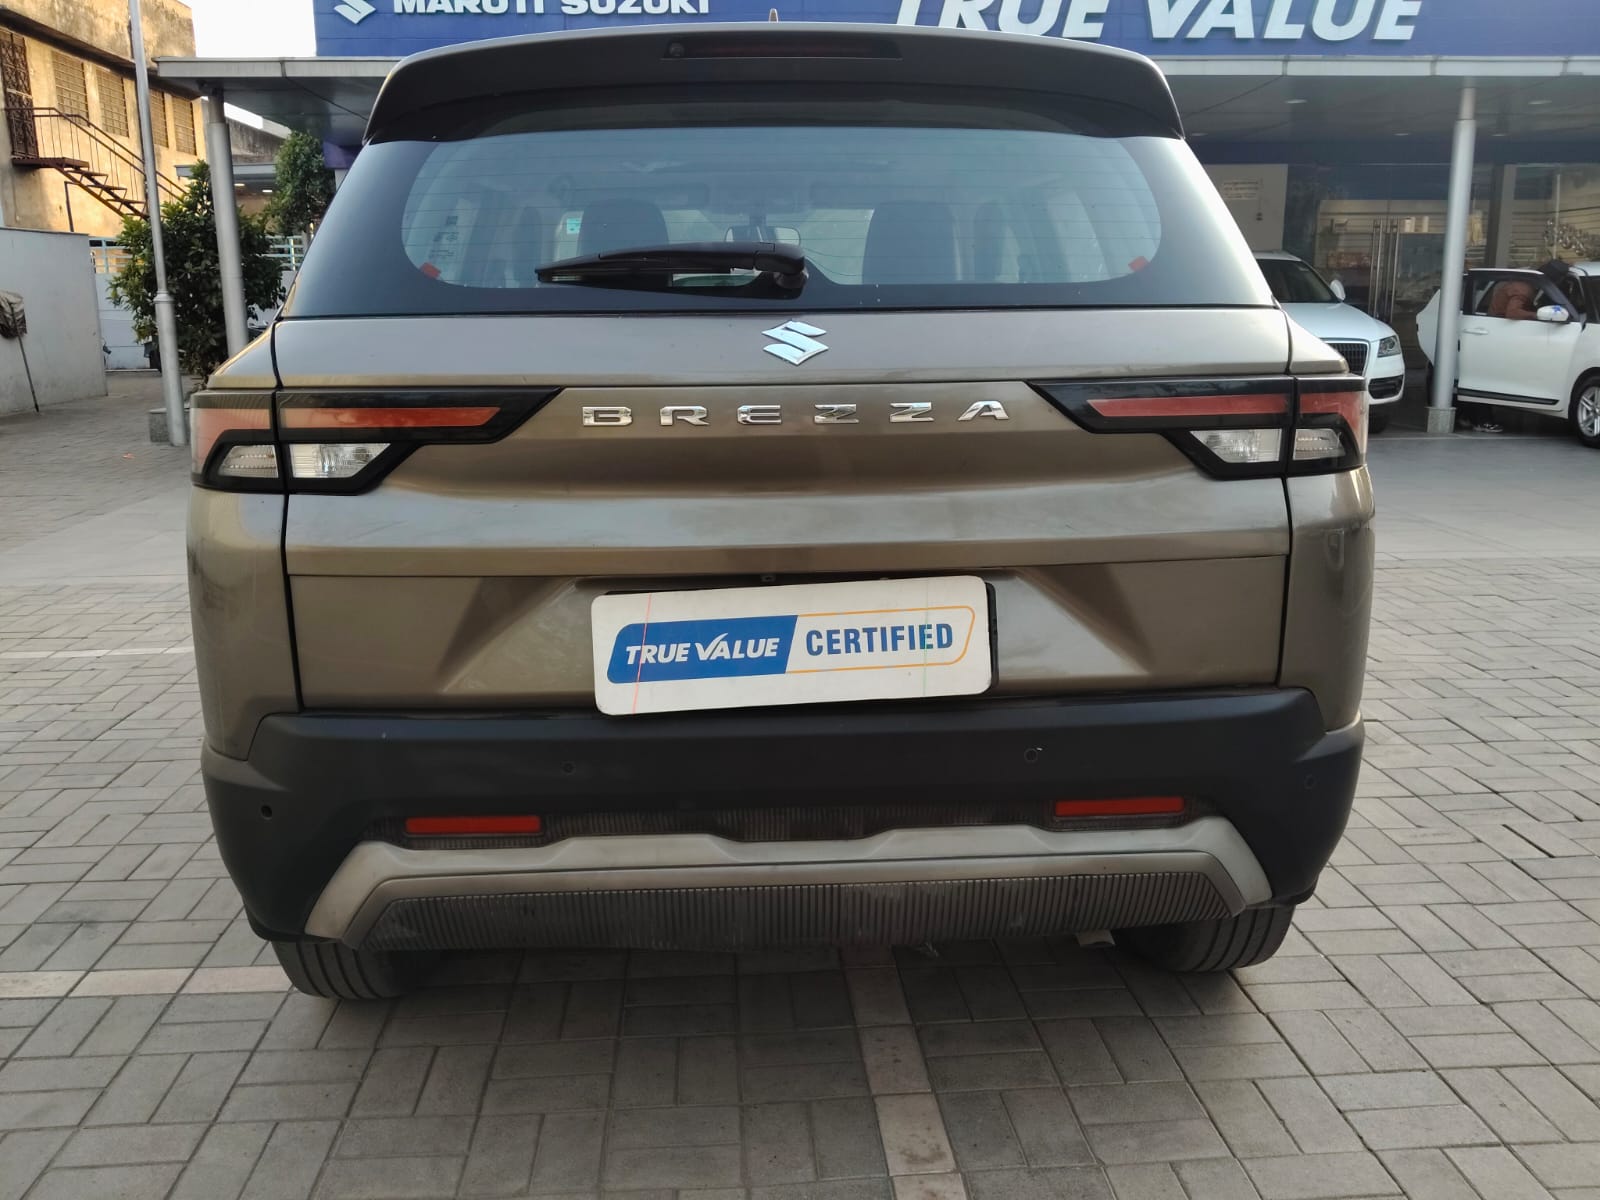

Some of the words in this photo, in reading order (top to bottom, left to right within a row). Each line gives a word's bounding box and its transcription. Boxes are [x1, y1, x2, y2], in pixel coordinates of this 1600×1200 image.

[561, 0, 709, 14] SUZUKI
[896, 0, 1109, 38] RUE
[1147, 0, 1422, 40] VALUE
[582, 400, 1010, 426] BREZZA
[626, 642, 691, 665] TRUE
[695, 633, 780, 661] VALUE
[805, 623, 954, 656] CERTIFIED
